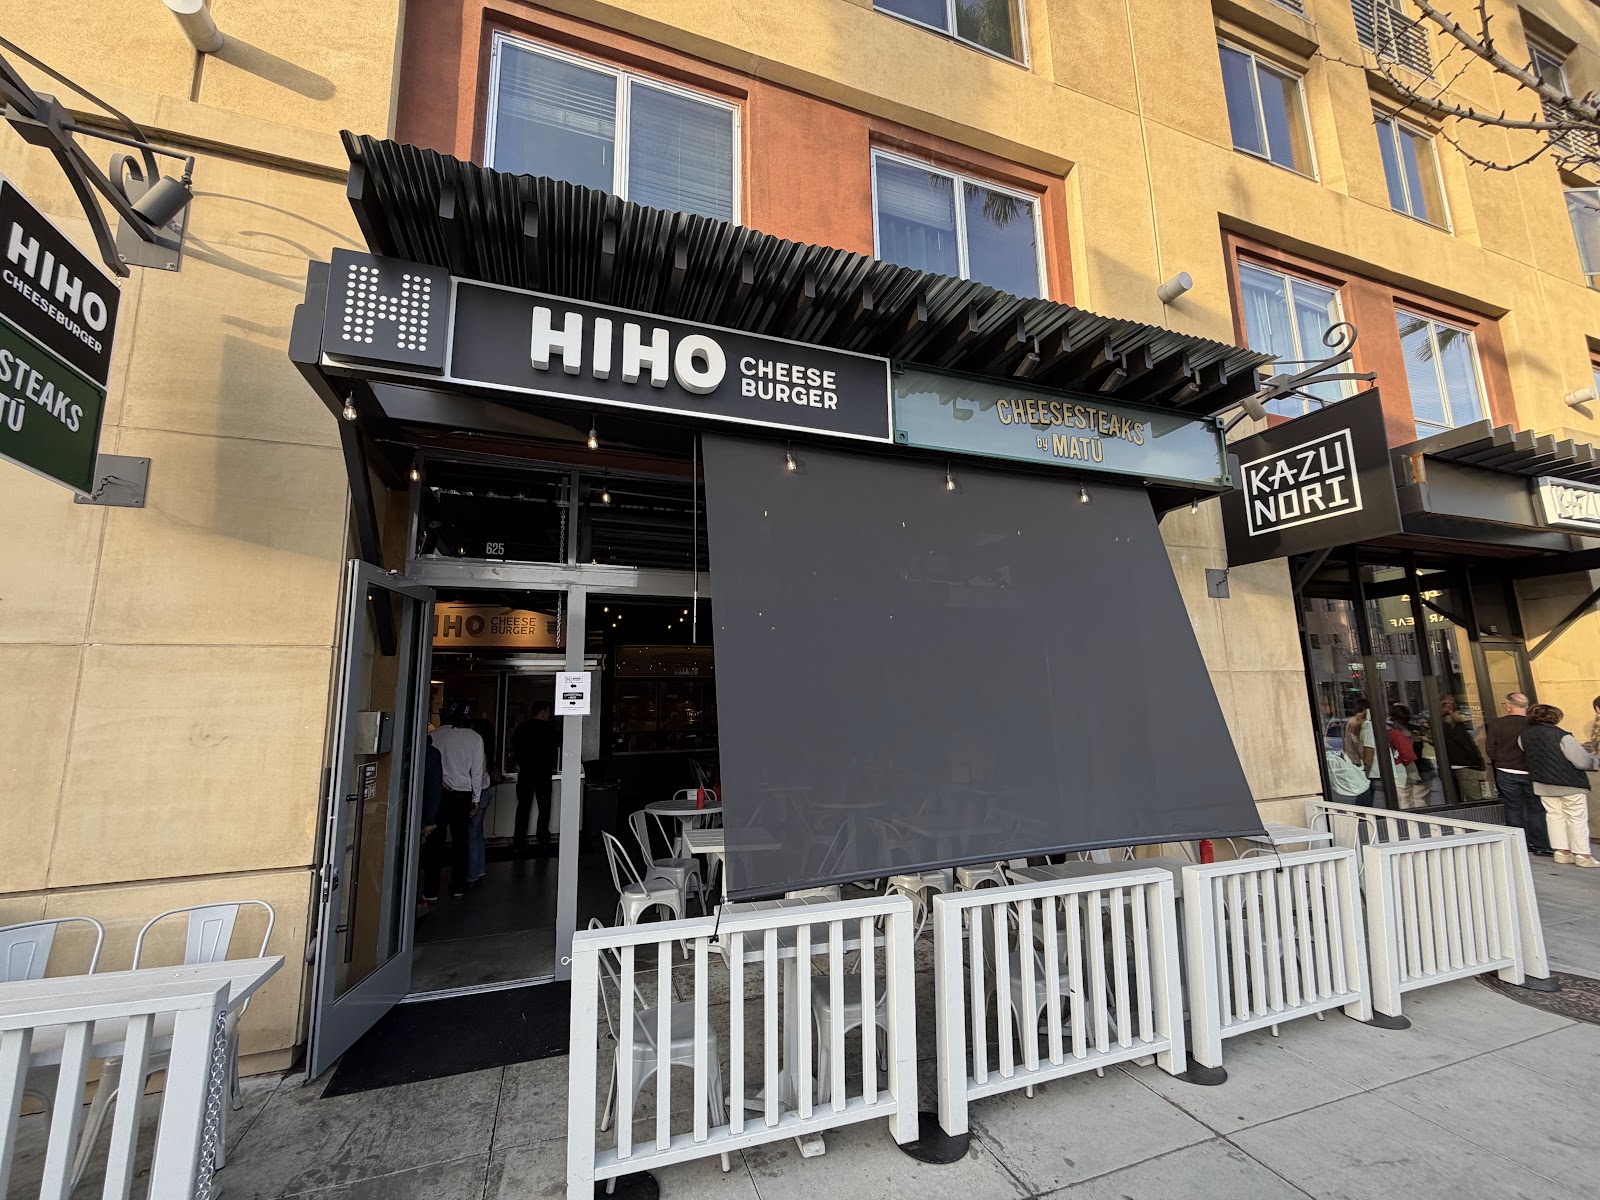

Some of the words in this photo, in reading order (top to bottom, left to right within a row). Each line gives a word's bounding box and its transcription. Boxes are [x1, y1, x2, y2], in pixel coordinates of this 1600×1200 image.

[7, 221, 108, 332] HIHO
[2, 268, 103, 354] CHEESEBURGER
[342, 264, 431, 351] H
[530, 306, 727, 395] HIHO
[740, 356, 837, 390] CHEESE
[741, 378, 838, 410] BURGER
[996, 399, 1145, 446] CHEESESTEAKS
[1036, 435, 1048, 451] by
[1250, 441, 1344, 496] KAZU
[1254, 475, 1349, 526] NORI
[485, 541, 505, 556] 625
[433, 614, 485, 638] IHO
[490, 616, 537, 627] CHEESE
[490, 626, 536, 635] BURGER
